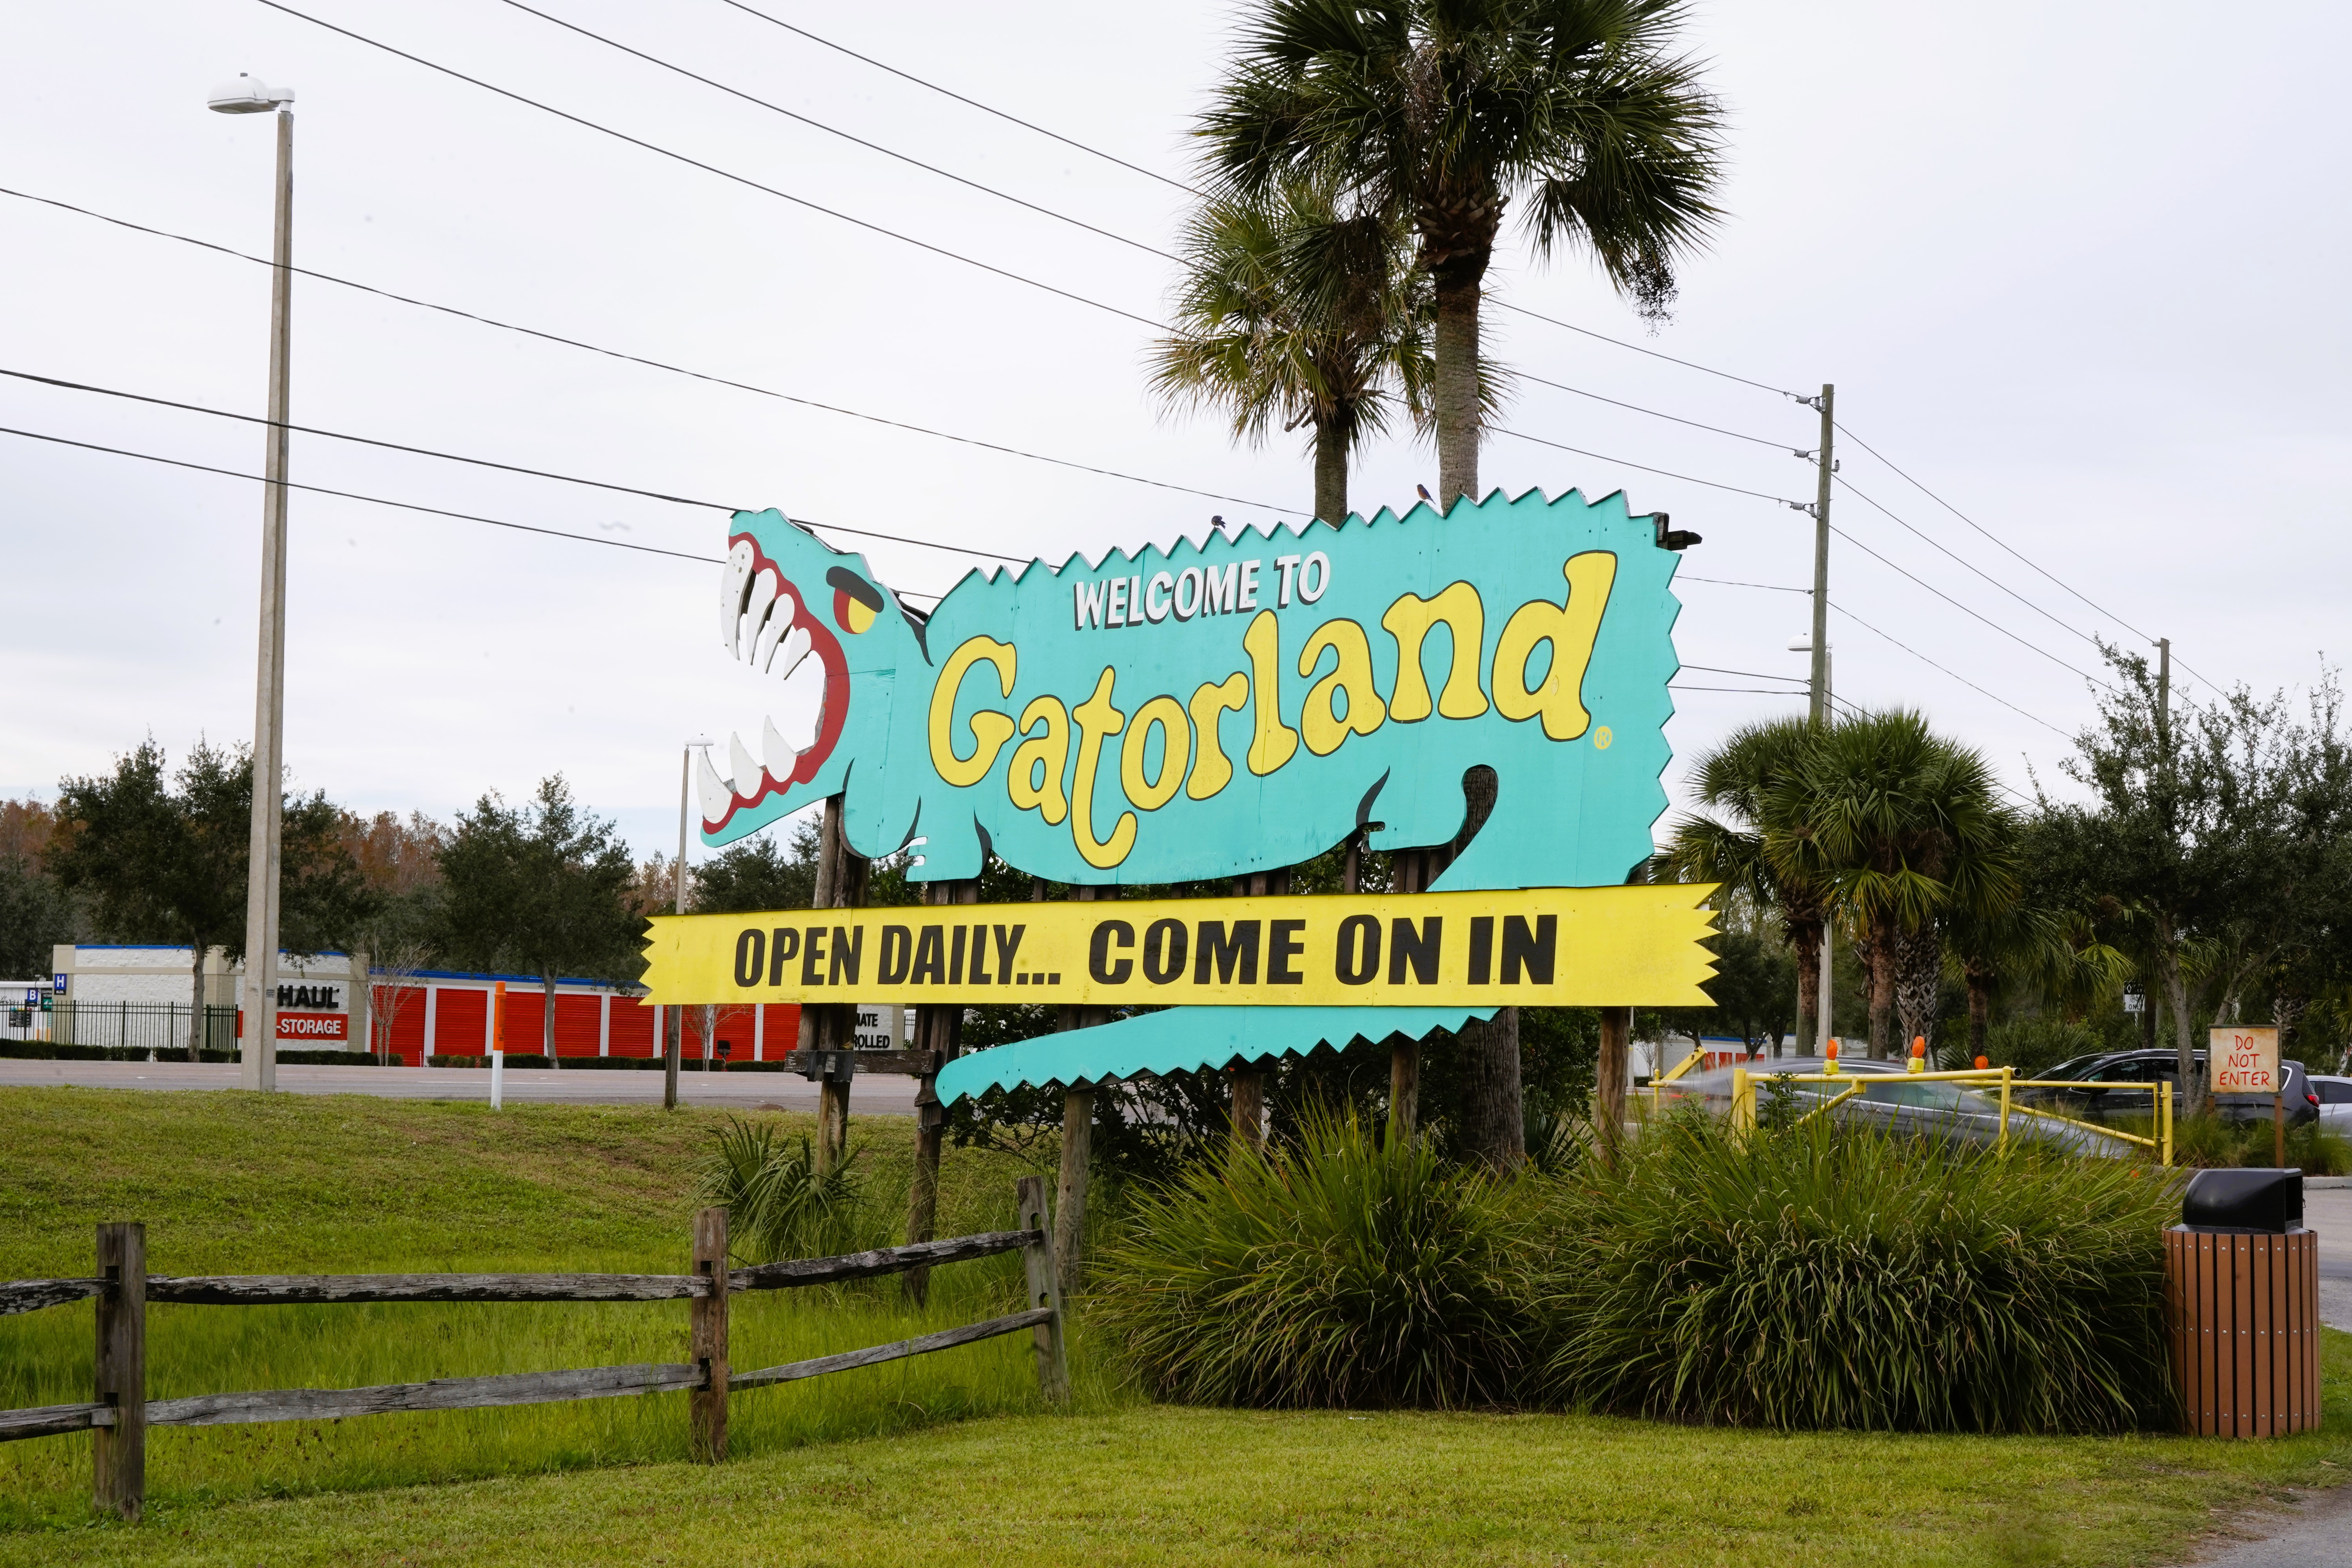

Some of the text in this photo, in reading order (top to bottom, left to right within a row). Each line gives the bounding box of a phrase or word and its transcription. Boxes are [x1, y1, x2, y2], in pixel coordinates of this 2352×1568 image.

[1074, 551, 1330, 631] WELCOME TO
[928, 550, 1617, 870] Gatorland
[734, 914, 1558, 987] OPEN DAILY... COME ON IN
[56, 976, 64, 987] H
[29, 990, 36, 1000] B
[2235, 1035, 2253, 1051] DO
[2229, 1053, 2260, 1068] NOT
[2220, 1071, 2270, 1086] ENTER
